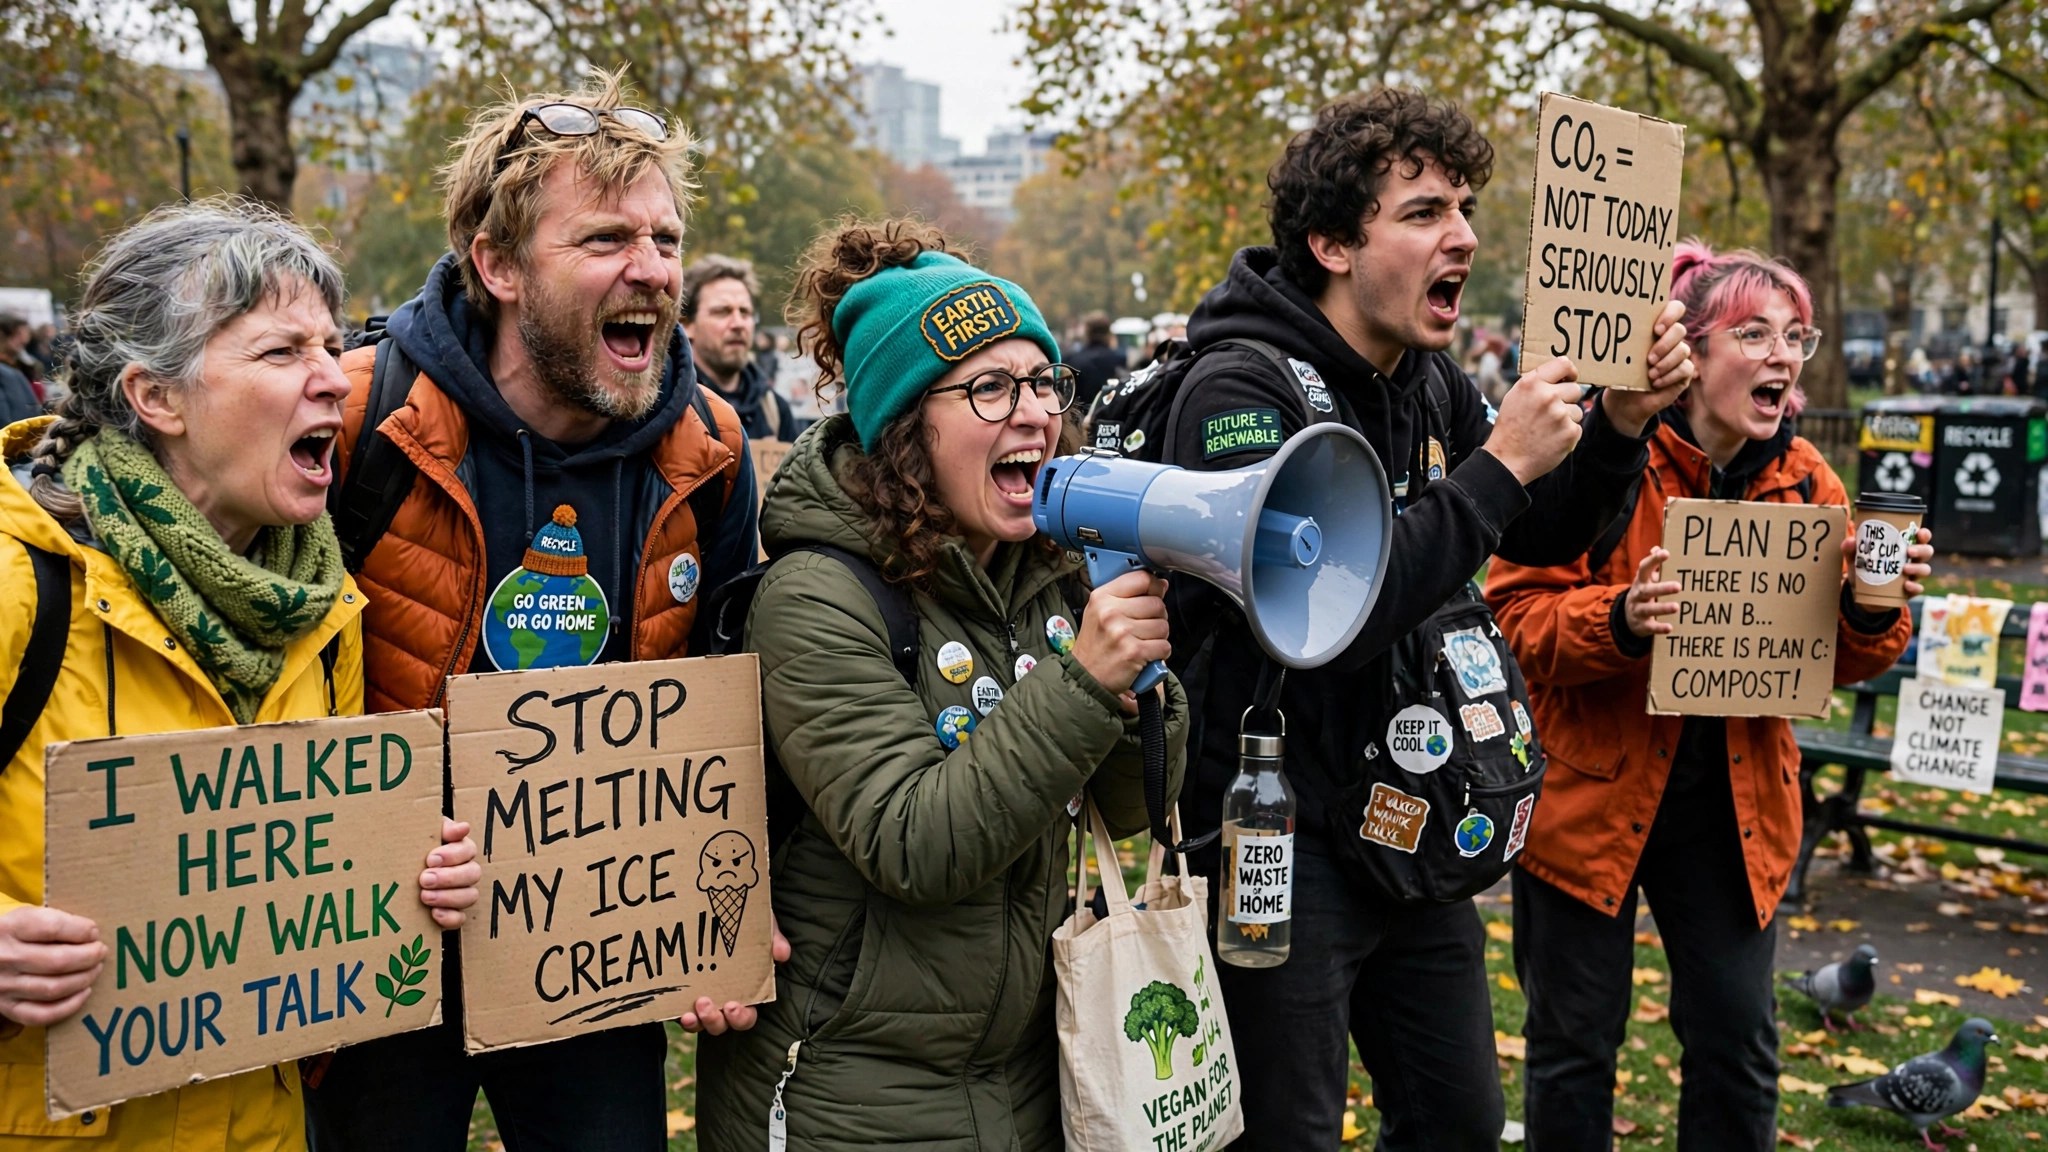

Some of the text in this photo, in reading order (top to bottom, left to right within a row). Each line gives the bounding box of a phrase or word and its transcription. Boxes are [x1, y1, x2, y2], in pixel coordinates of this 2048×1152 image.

[1544, 184, 1673, 250] NOT TODAY.
[1539, 243, 1665, 305] SERIOUSLY.
[931, 289, 997, 332] EARTH
[944, 306, 1010, 350] FIRST!
[1551, 305, 1632, 364] STOP.
[1207, 412, 1258, 438] FUTURE
[1944, 425, 2014, 448] RECYCLE
[1206, 429, 1280, 454] RENEWABLE
[541, 535, 578, 552] RECYCLE
[1683, 515, 1831, 562] PLAN B?
[1865, 524, 1885, 540] THIS
[1878, 543, 1900, 558] CUP
[1677, 569, 1806, 595] THERE IS NO
[513, 593, 586, 611] GO GREEN
[1679, 601, 1773, 626] PLAN B...
[506, 613, 597, 631] OR GO HOME
[1666, 636, 1829, 660] THERE IS PLAN C:
[1671, 668, 1801, 700] COMPOST!
[1919, 690, 1990, 717] CHANGE
[495, 678, 687, 775] STOP
[1396, 719, 1441, 735] KEEP IT
[1929, 715, 1966, 733] NOT
[1393, 737, 1425, 752] COOL
[1908, 732, 1982, 759] CLIMATE
[1906, 754, 1979, 780] CHANGE
[87, 733, 412, 830] I WALKED
[483, 755, 736, 863] MELTING
[178, 813, 354, 896] HERE.
[1243, 844, 1283, 865] ZERO
[1239, 866, 1288, 887] WASTE
[490, 848, 676, 939] MY ICE
[1239, 894, 1284, 914] HOME
[116, 882, 401, 990] NOW WALK
[534, 910, 721, 1002] CREAM!!
[82, 960, 367, 1077] YOUR TALK
[1142, 1052, 1229, 1128] VEGAN FOR
[1152, 1122, 1187, 1152] THE
[1192, 1080, 1232, 1140] PLANET
